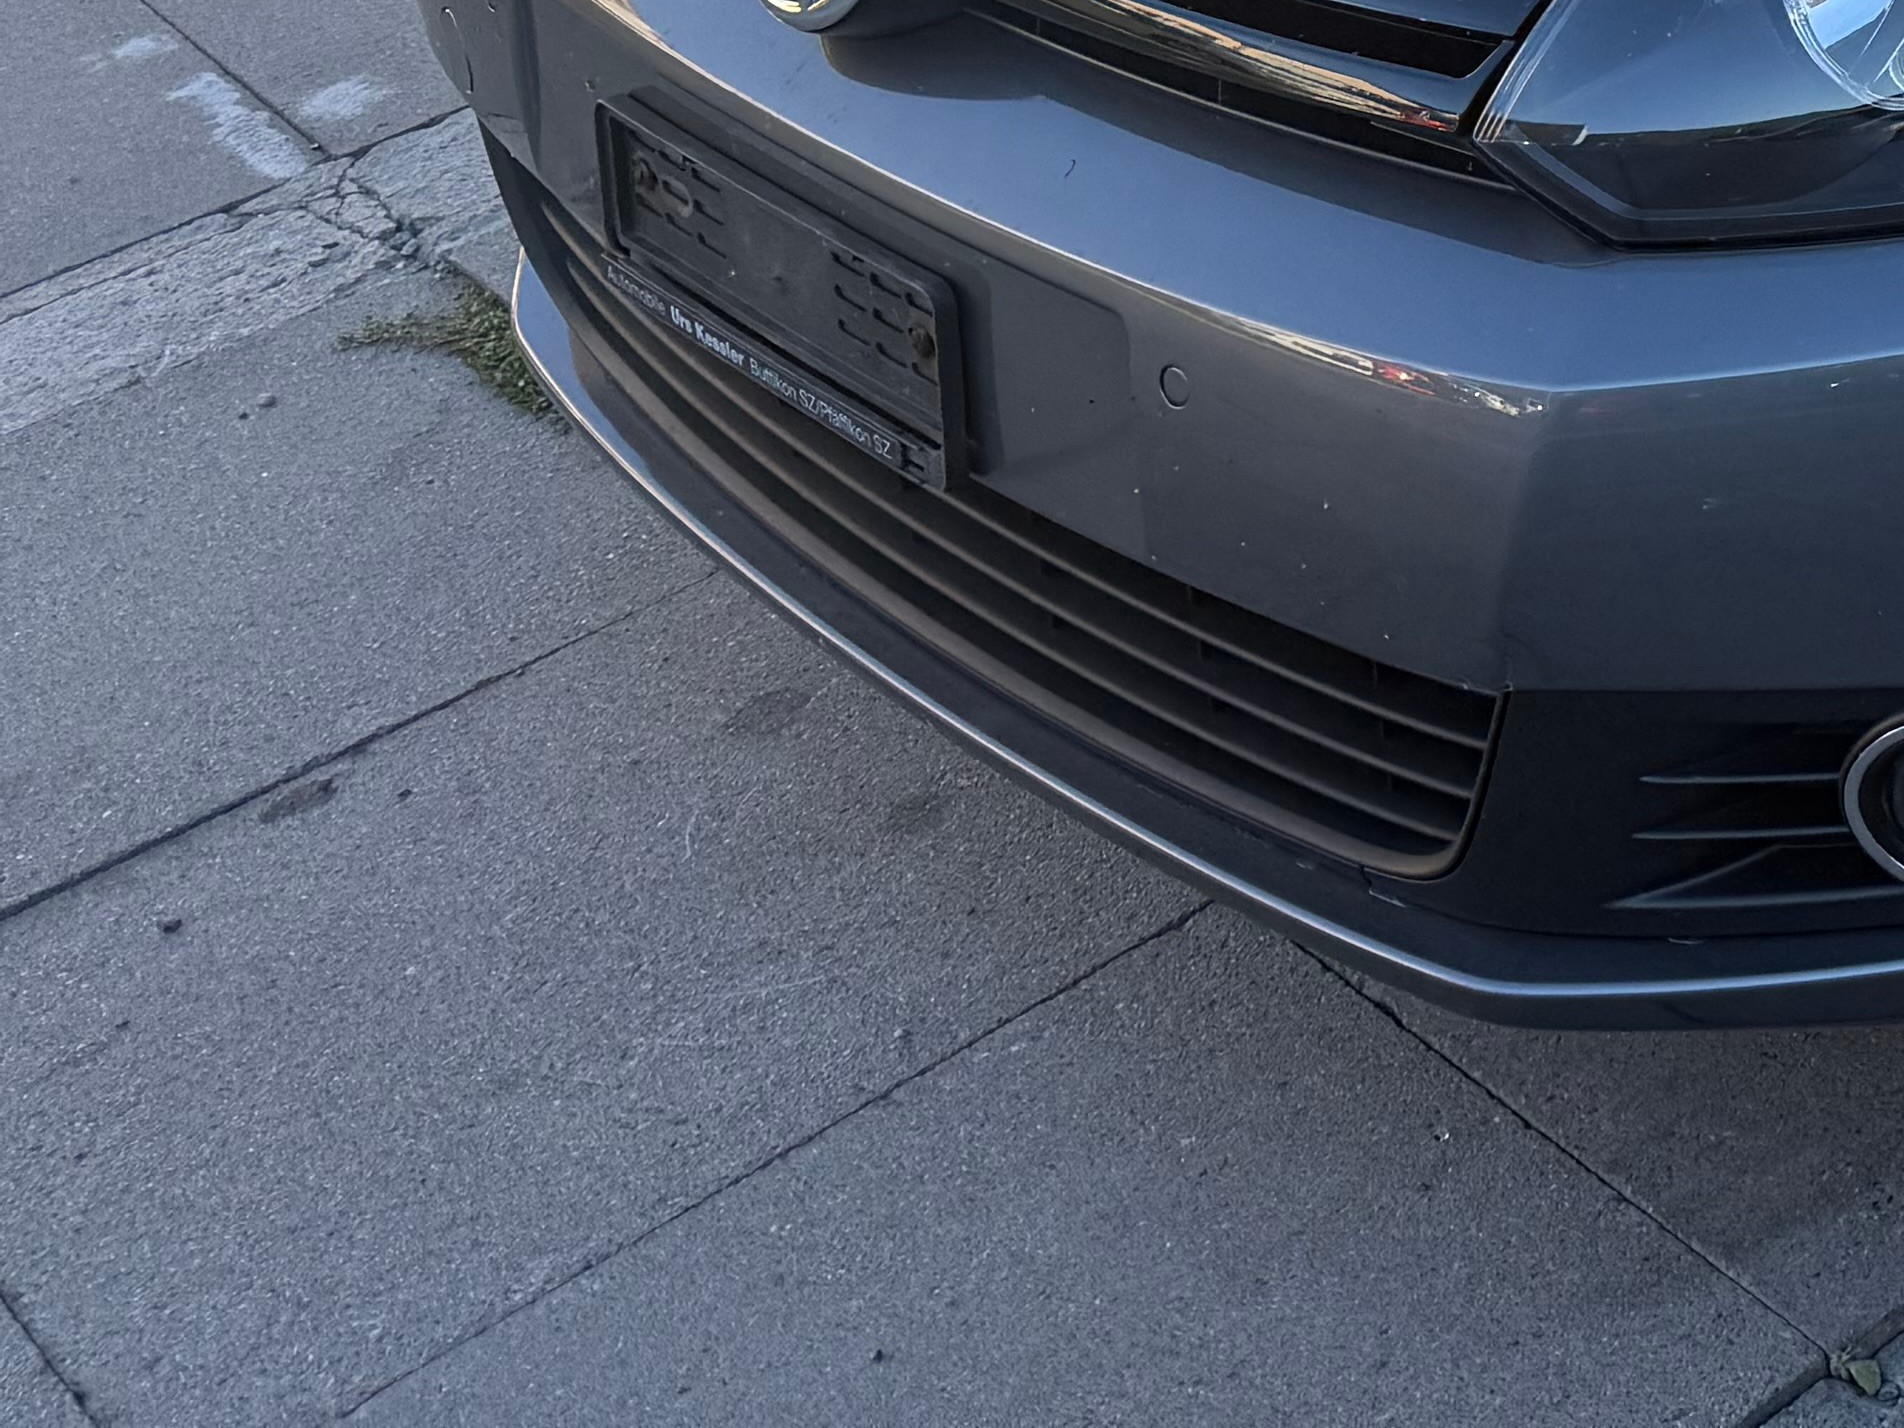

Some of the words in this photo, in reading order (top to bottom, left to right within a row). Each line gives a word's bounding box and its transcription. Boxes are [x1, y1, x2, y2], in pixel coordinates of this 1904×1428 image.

[670, 305, 693, 334] Urs
[694, 321, 745, 366] Kessler
[872, 434, 893, 460] SZ
